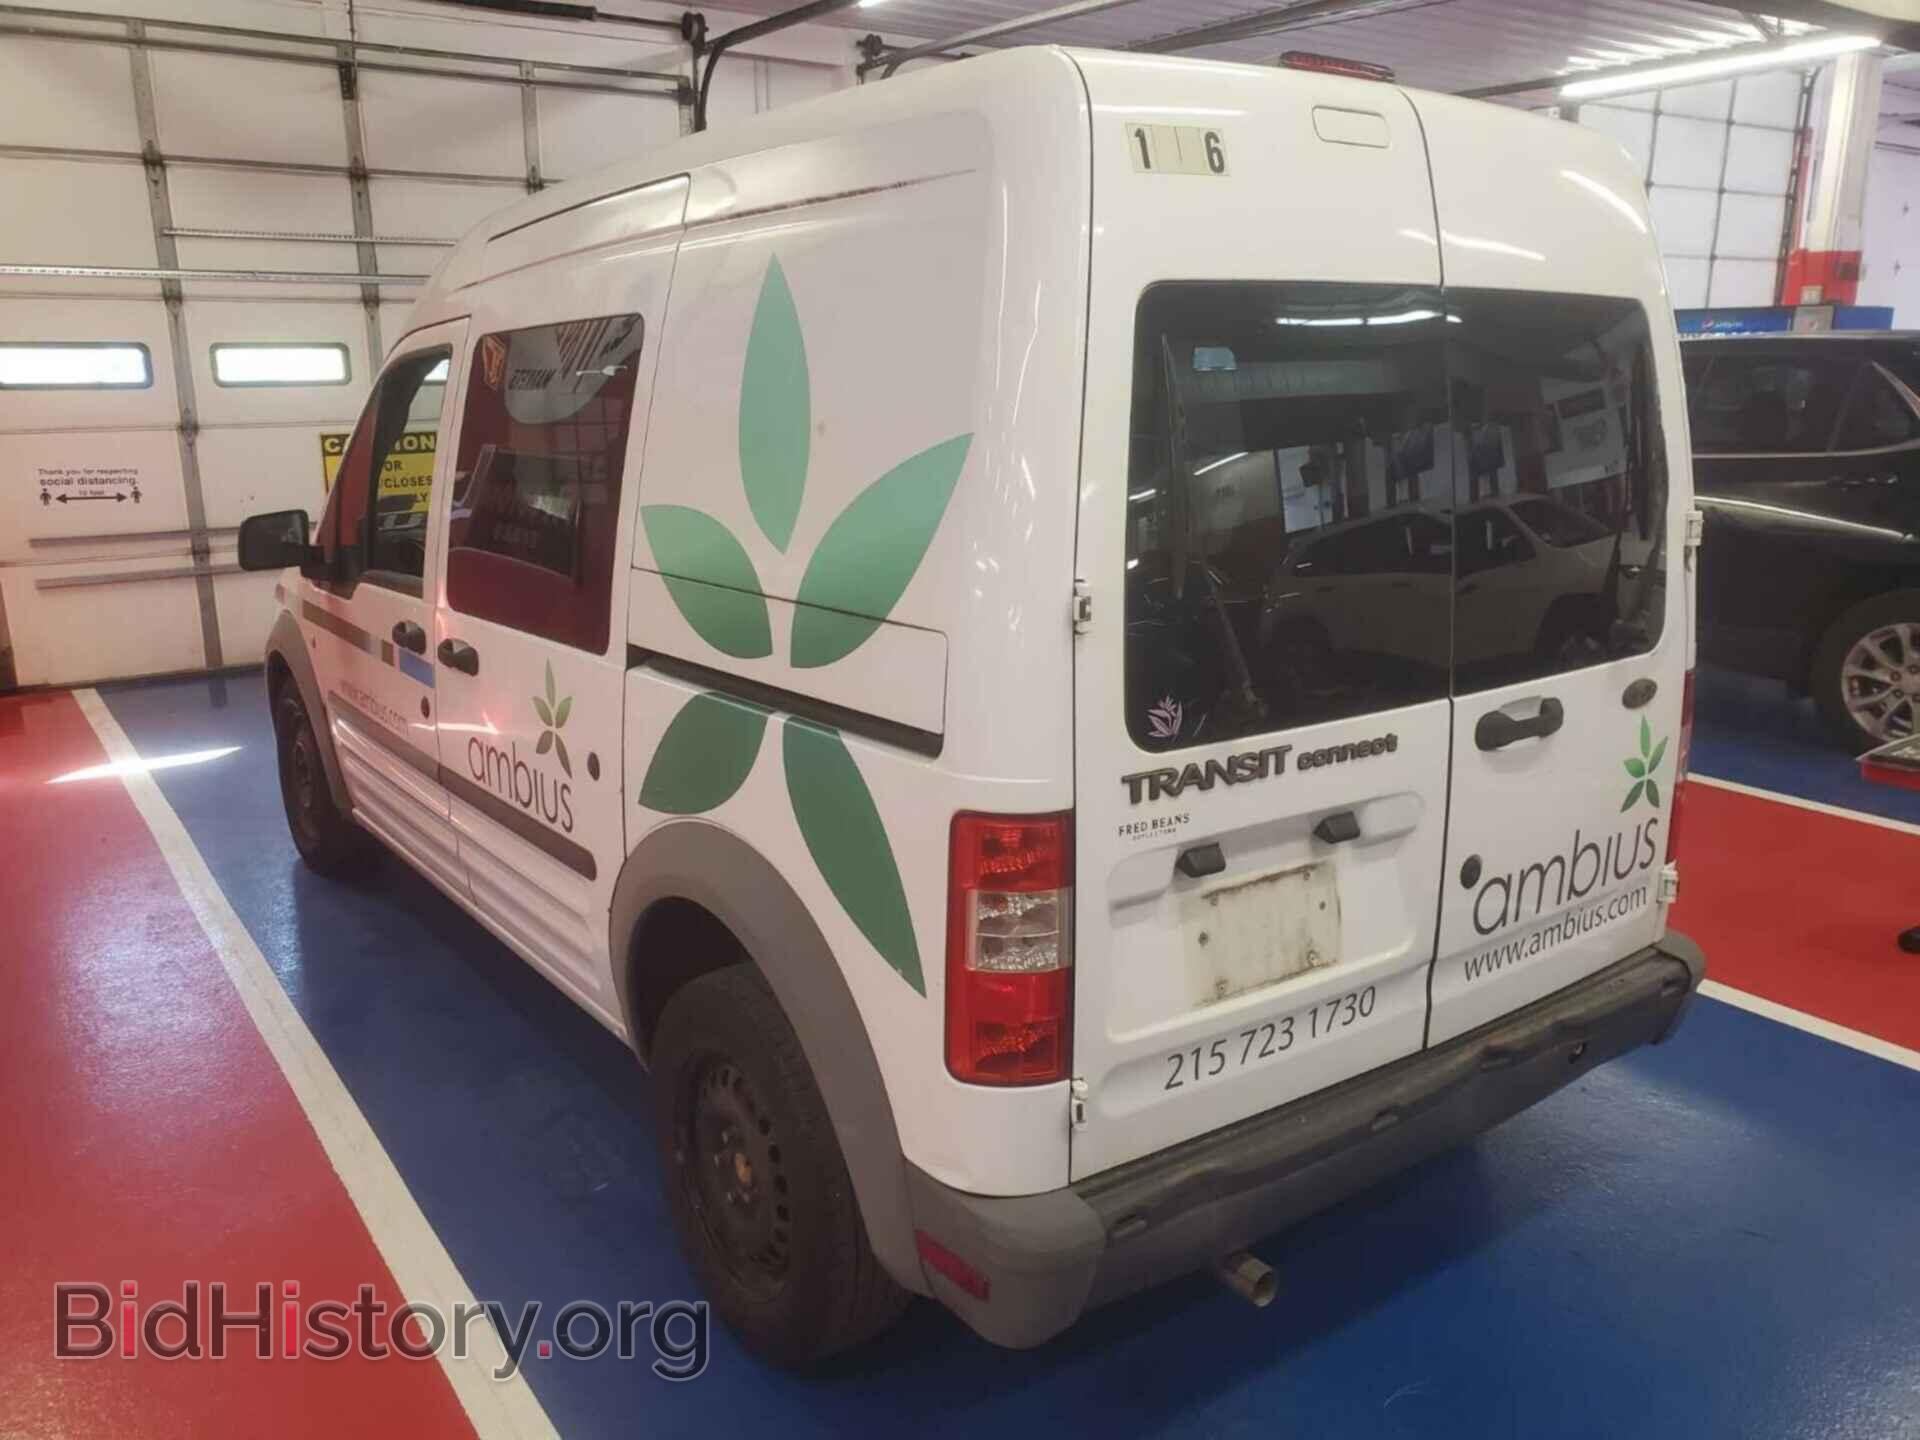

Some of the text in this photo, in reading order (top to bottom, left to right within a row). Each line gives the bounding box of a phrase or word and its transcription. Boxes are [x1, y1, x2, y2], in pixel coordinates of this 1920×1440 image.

[1134, 127, 1225, 174] 1 6
[323, 434, 434, 453] CION
[40, 477, 75, 486] social
[468, 736, 574, 834] ambius
[1120, 732, 1399, 805] TRANSIT connect
[1118, 812, 1190, 837] FRED BEANS
[1473, 816, 1659, 935] ambius
[1463, 885, 1648, 981] www.ambius.com
[1164, 985, 1376, 1090] 215 723 1730
